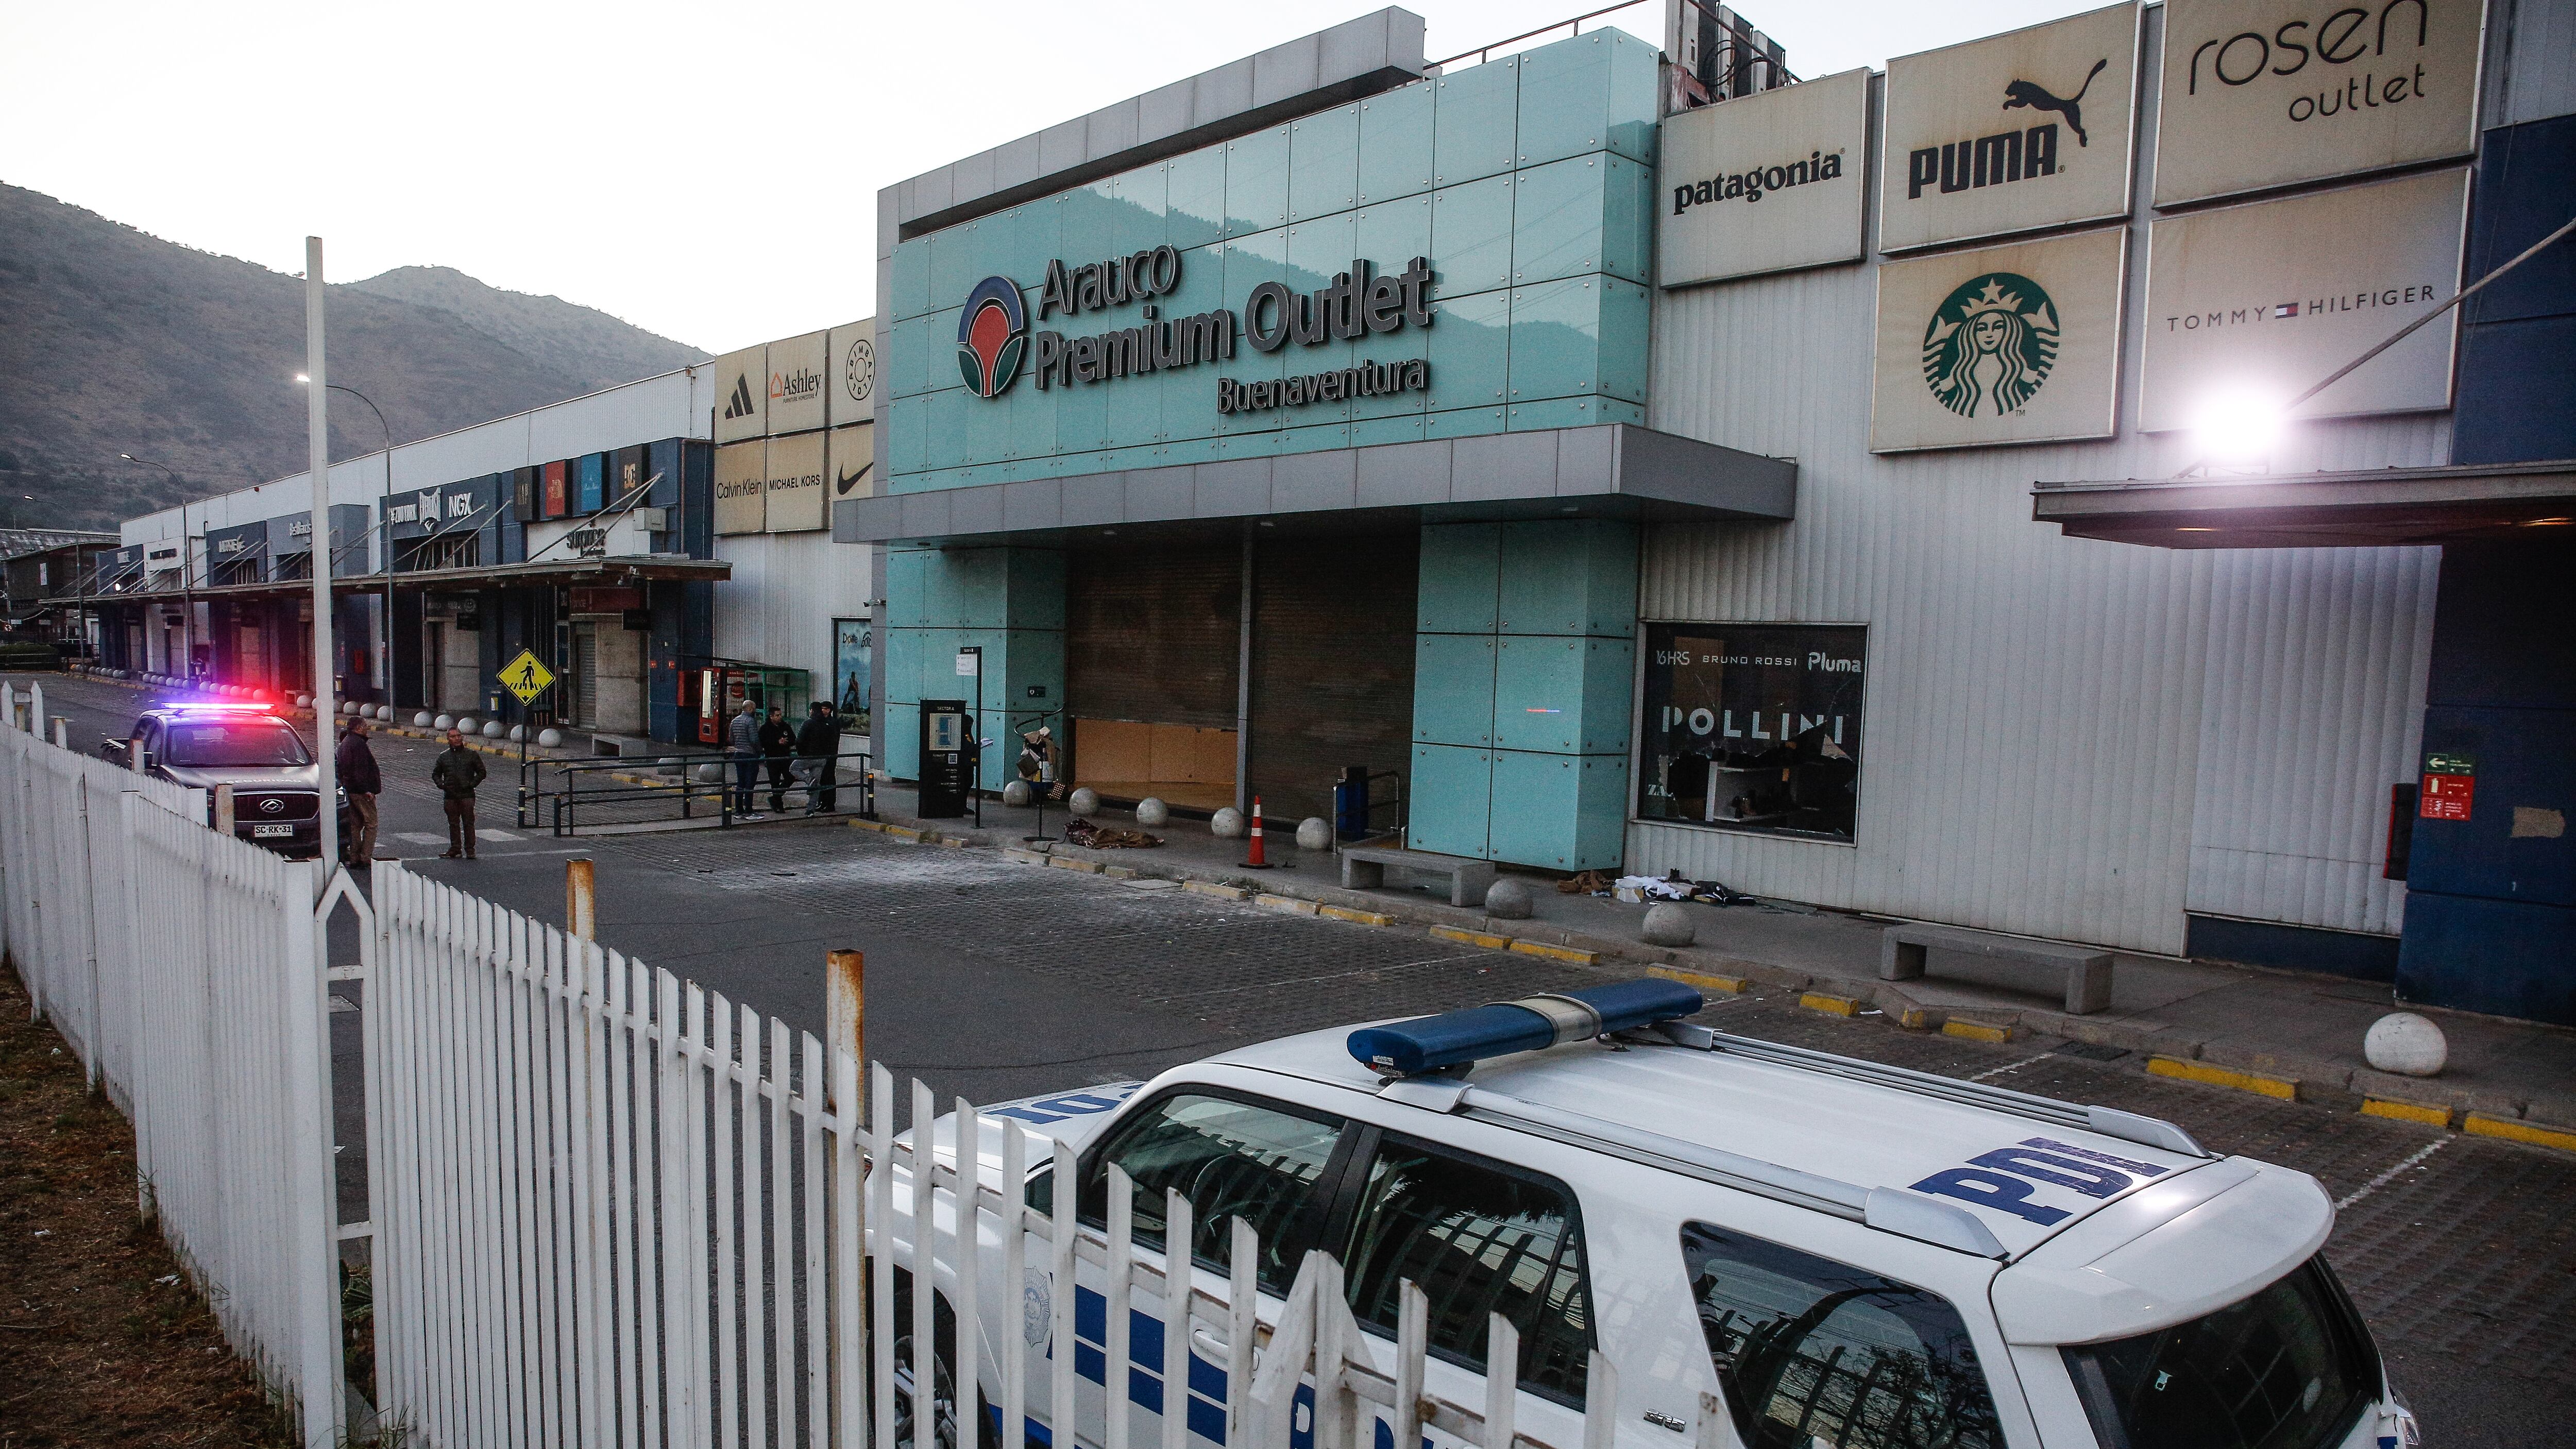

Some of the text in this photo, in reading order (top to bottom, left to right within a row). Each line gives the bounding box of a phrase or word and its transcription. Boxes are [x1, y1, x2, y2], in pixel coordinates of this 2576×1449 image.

[2189, 0, 2427, 95] rosen
[2289, 63, 2426, 122] outlet
[1673, 151, 1842, 215] patagonia
[1908, 124, 2058, 200] PUMA
[1037, 243, 1181, 321] Arauco
[2167, 285, 2434, 332] TOMMY HILFIGER
[1035, 255, 1435, 390] Premium Outlet
[783, 367, 821, 396] Ashley
[1217, 358, 1429, 415] Buenaventura
[448, 492, 473, 518] NGX
[717, 478, 762, 499] Calvin Klein
[770, 474, 820, 490] MICHAEL KORS
[1702, 655, 1797, 666] BRUNO ROSSI
[1808, 652, 1862, 673] Pluma
[1908, 1136, 2171, 1227] PDI
